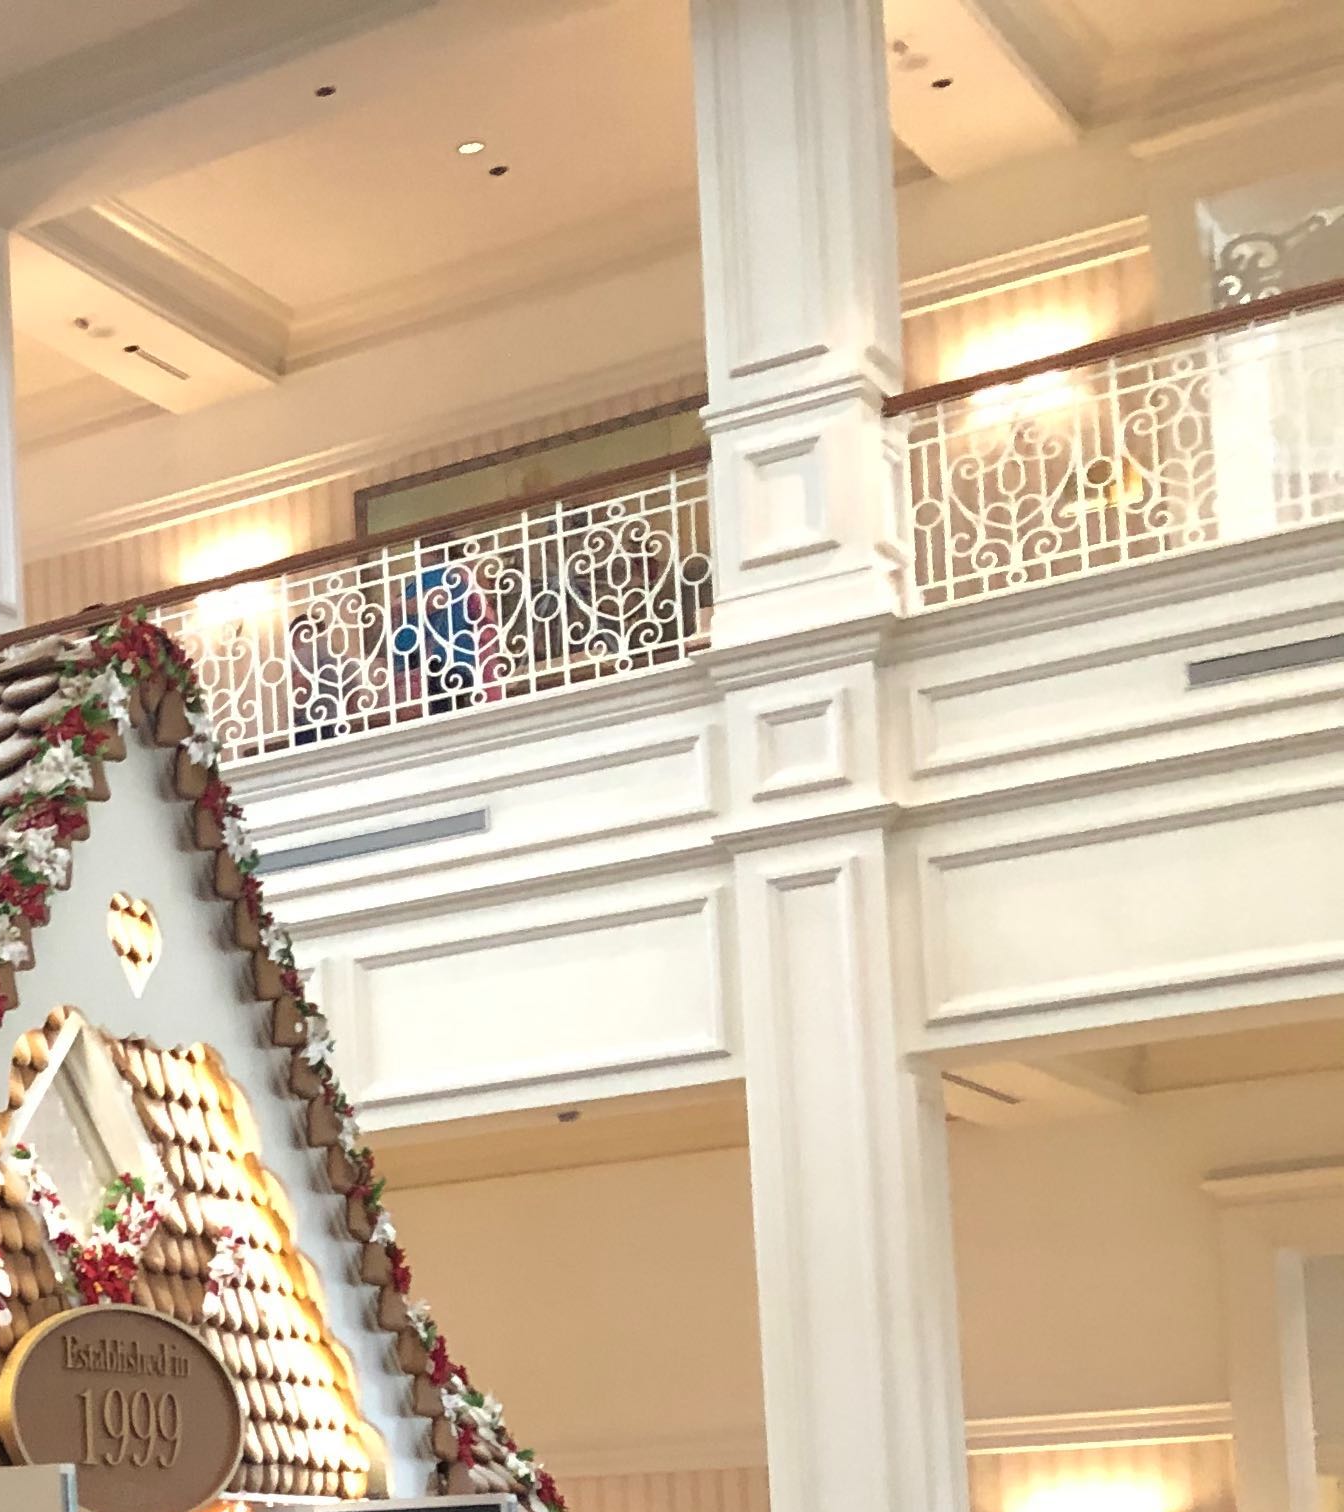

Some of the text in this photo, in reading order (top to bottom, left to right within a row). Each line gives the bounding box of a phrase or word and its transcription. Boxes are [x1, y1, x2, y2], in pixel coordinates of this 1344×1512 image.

[62, 1335, 190, 1378] Established in
[78, 1388, 183, 1468] 1999
